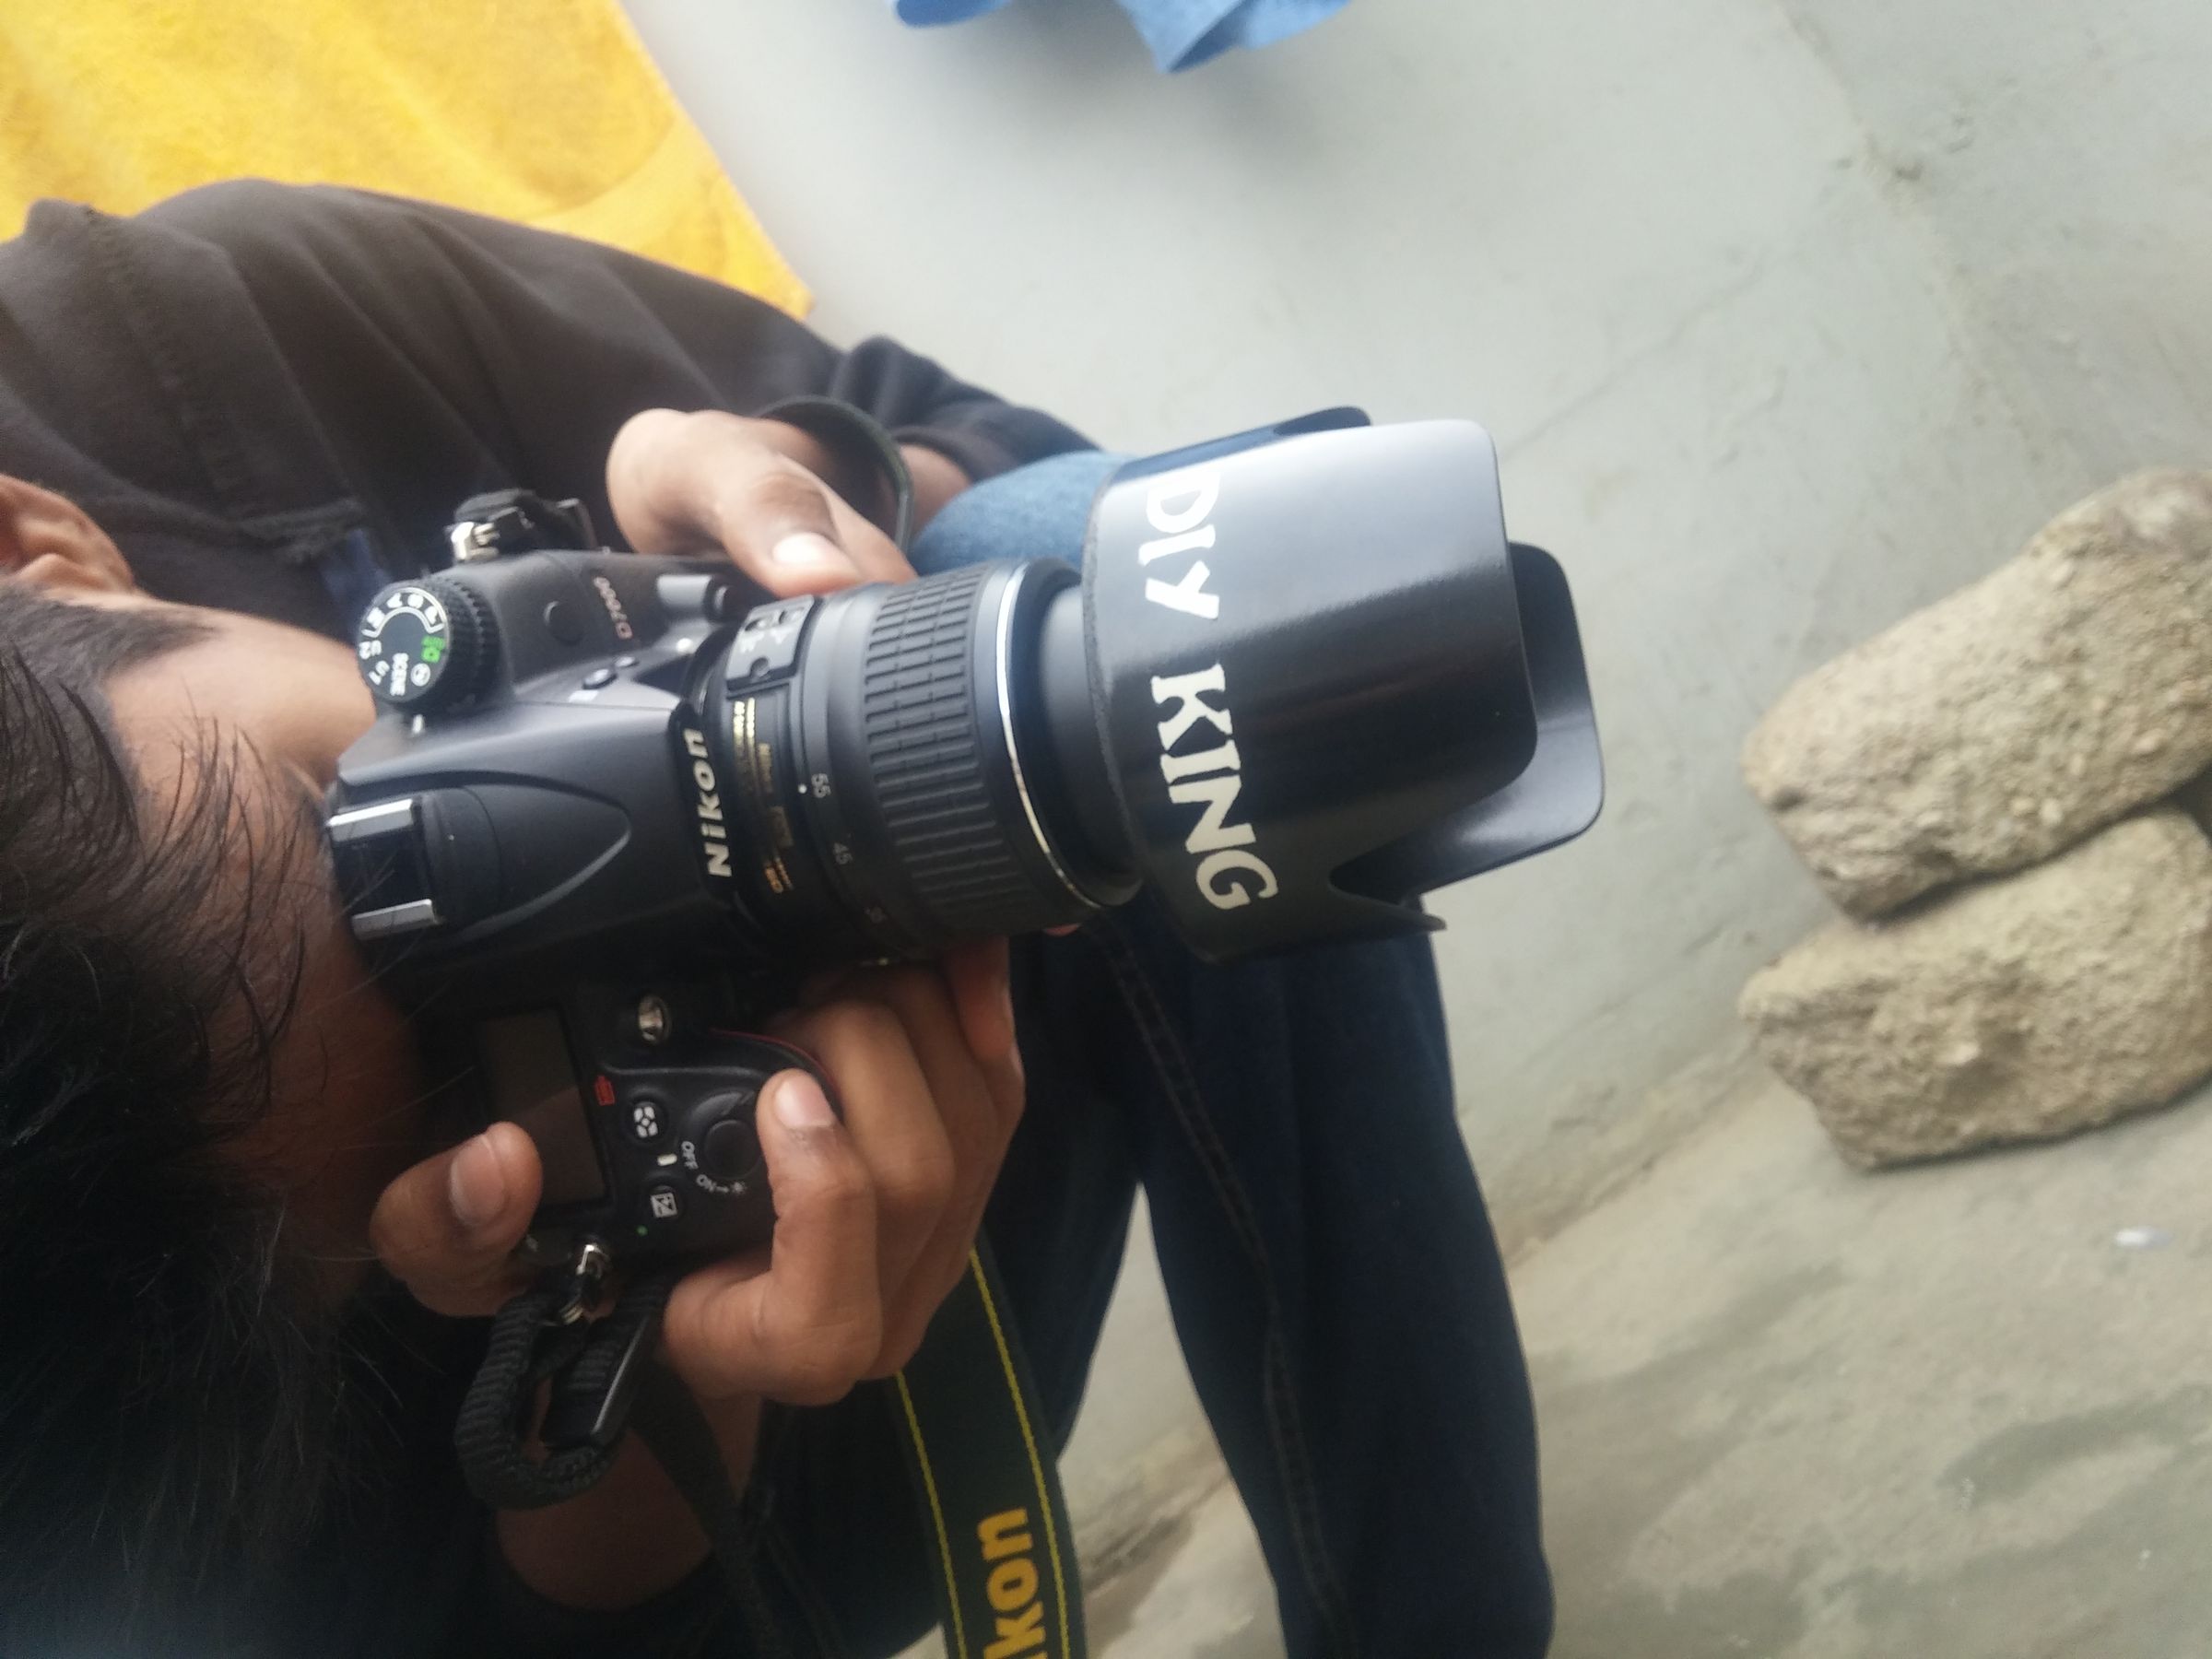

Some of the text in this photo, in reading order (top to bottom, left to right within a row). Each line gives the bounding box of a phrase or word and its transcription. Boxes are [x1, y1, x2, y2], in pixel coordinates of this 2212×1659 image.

[1138, 468, 1278, 910] DIY KING
[683, 728, 732, 877] Nikon
[977, 1507, 1049, 1659] kon
